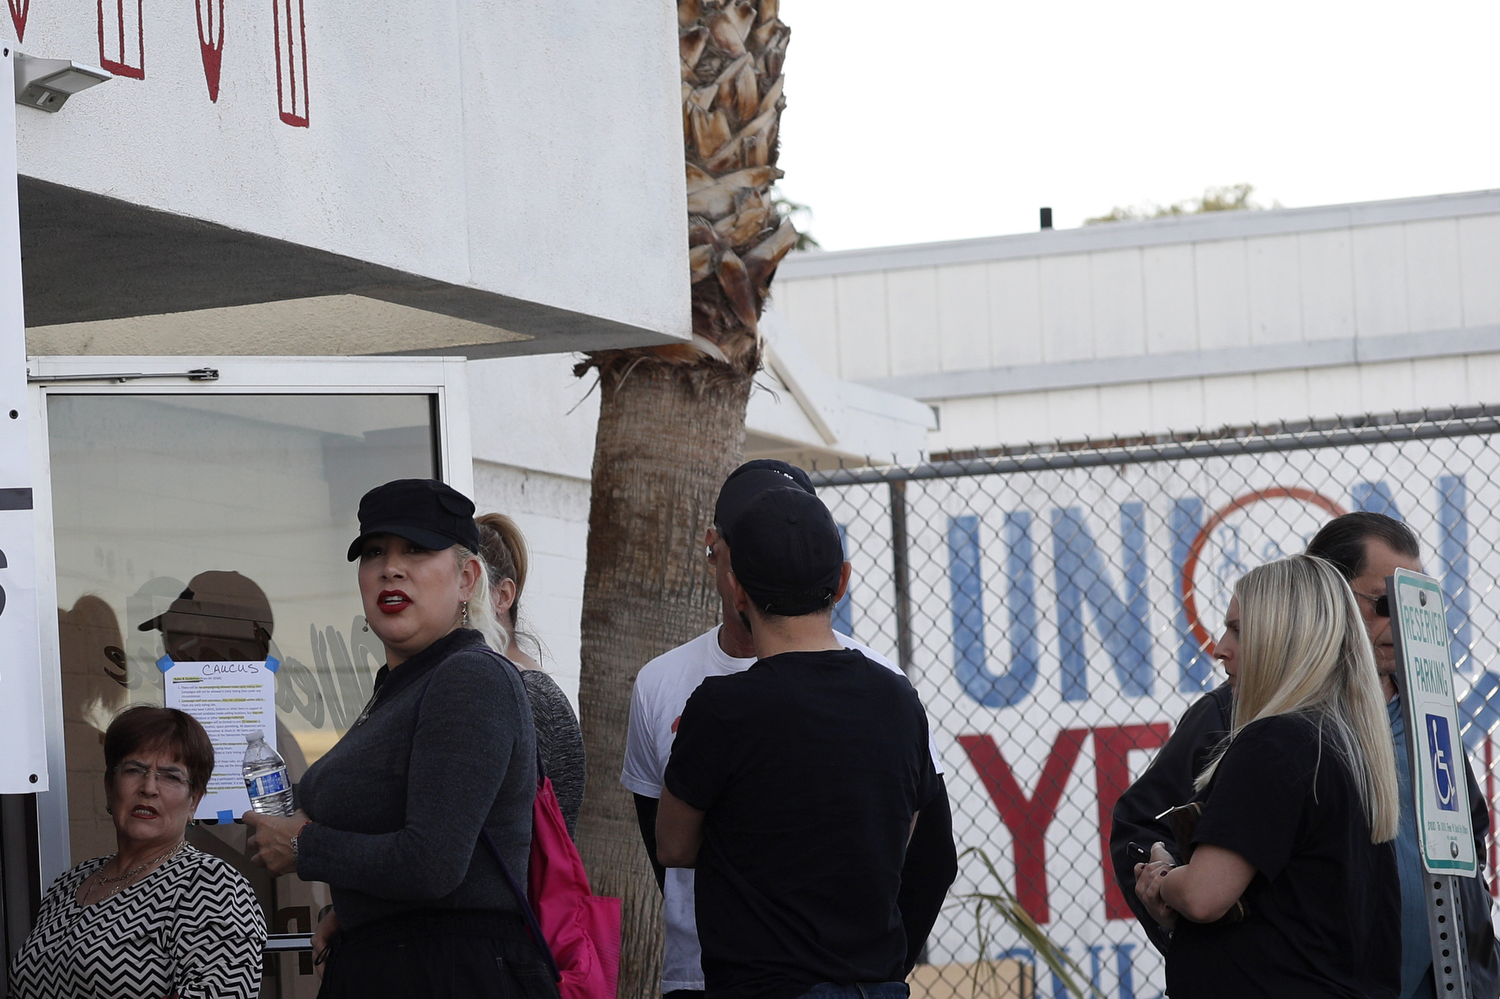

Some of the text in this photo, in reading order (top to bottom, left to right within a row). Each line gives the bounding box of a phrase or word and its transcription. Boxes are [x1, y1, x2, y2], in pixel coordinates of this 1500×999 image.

[1403, 605, 1445, 647] RESERVED
[202, 663, 259, 675] CAUCUS
[1414, 656, 1448, 694] PARKING
